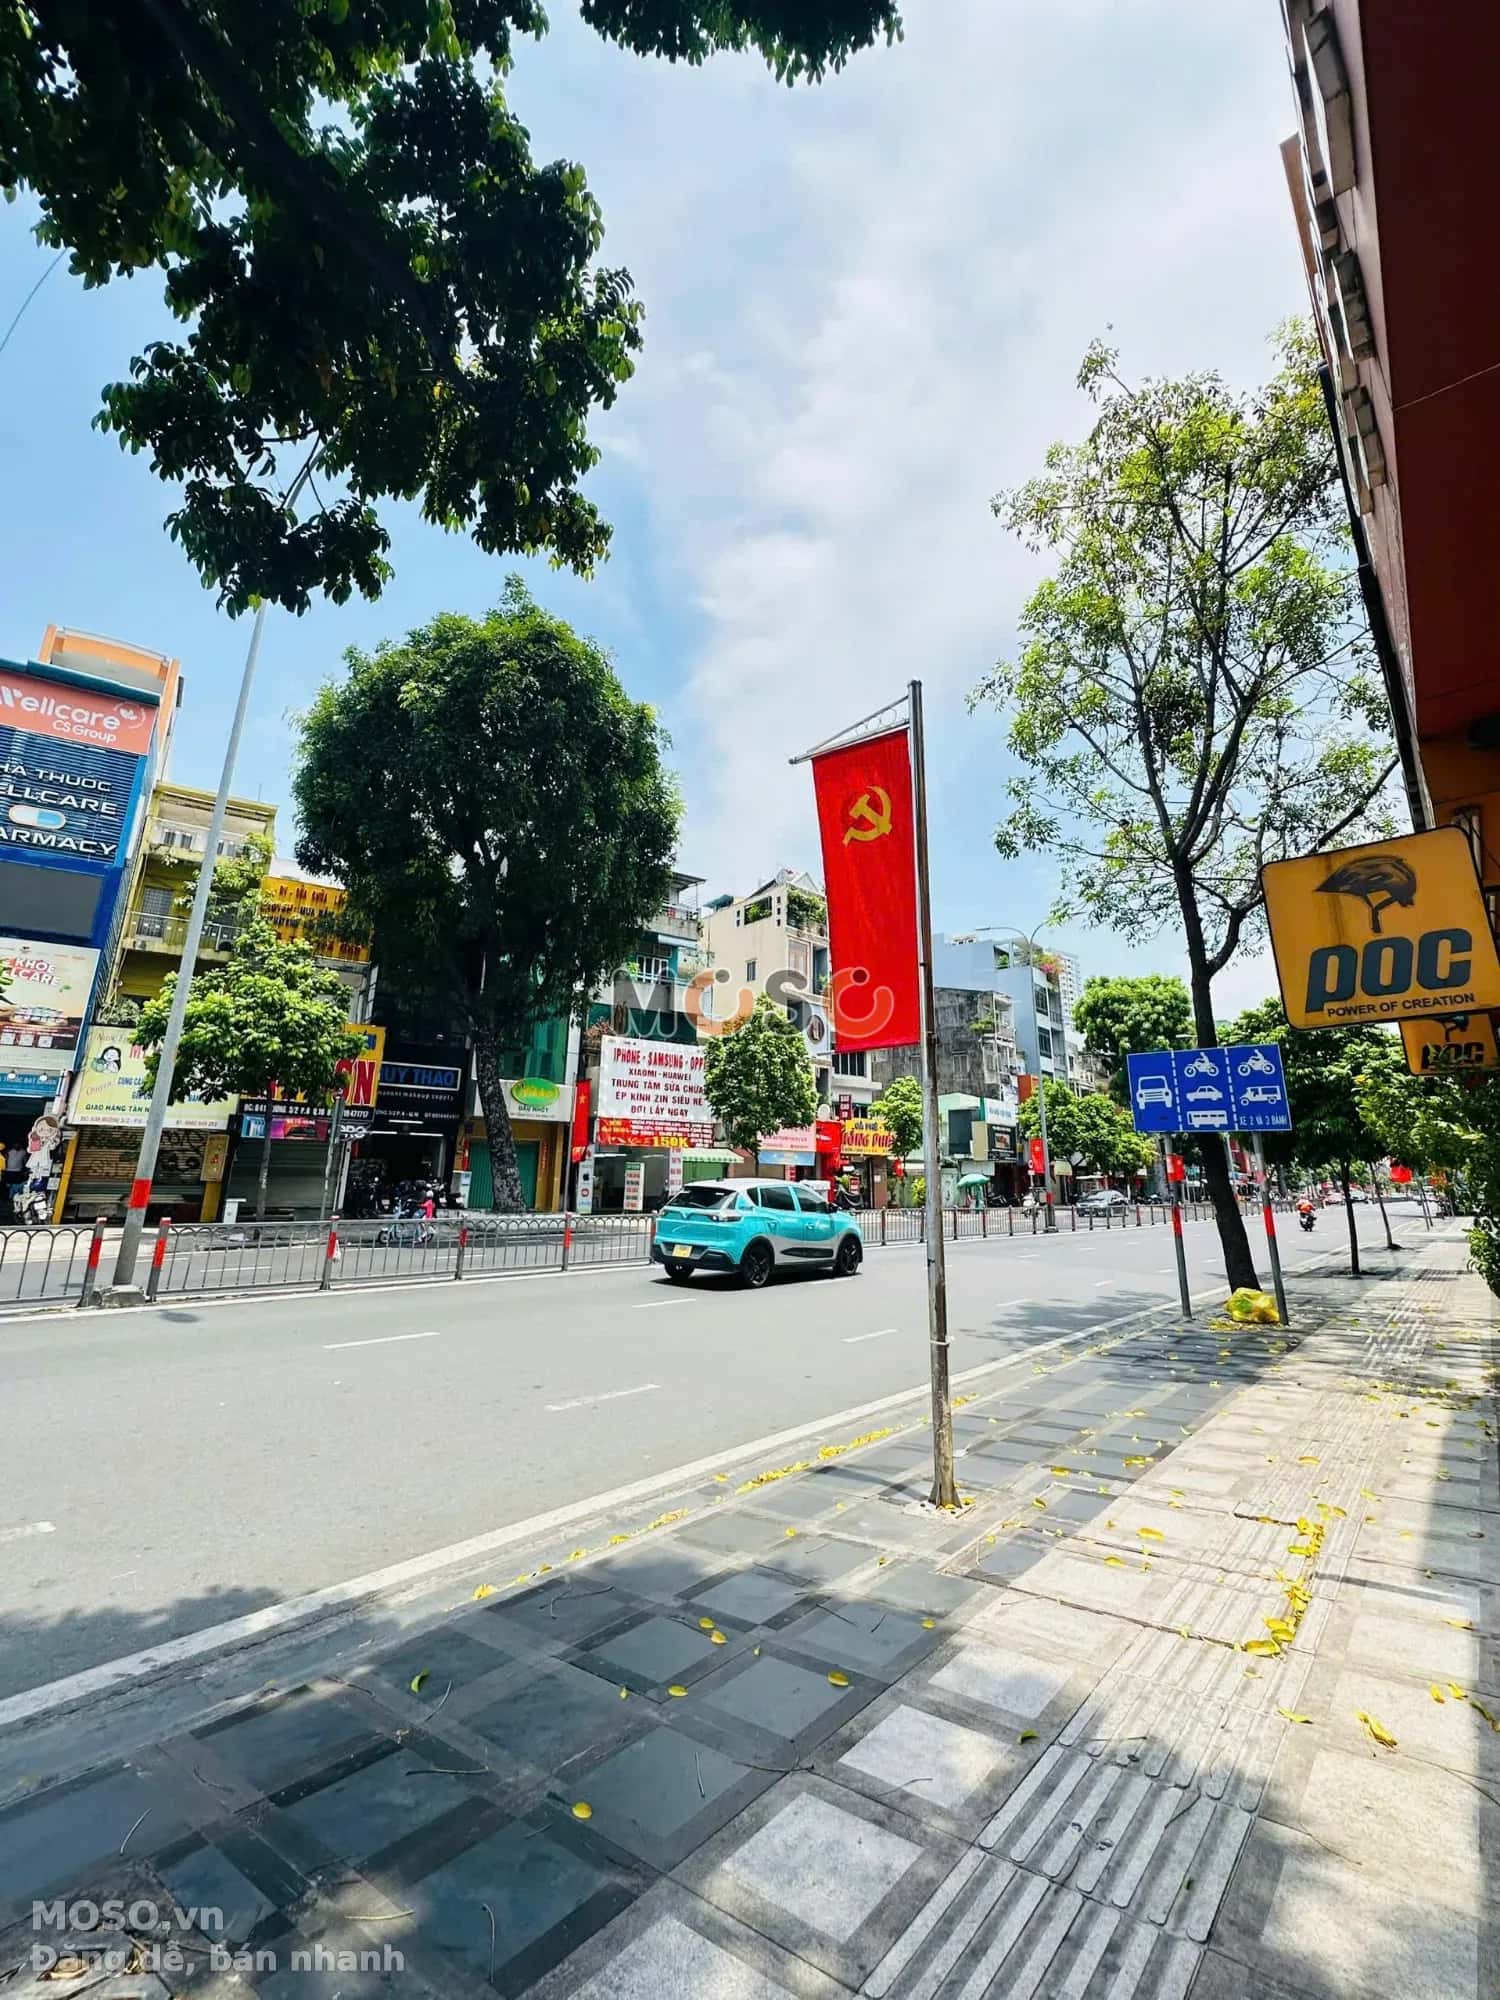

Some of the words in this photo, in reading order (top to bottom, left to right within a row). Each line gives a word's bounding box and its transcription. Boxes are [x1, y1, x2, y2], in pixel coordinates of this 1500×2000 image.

[52, 720, 71, 733] CS
[72, 725, 117, 744] Group
[1305, 928, 1472, 1014] POC
[1327, 1003, 1377, 1017] POWER
[1379, 1001, 1400, 1012] OF
[1402, 993, 1475, 1009] CREATION
[648, 1051, 683, 1069] SAMSUNG
[628, 1068, 657, 1078] XIAOMI
[662, 1071, 692, 1081] HUAWEI
[611, 1078, 639, 1089] TRUNG
[655, 1094, 668, 1104] ZIN
[1250, 1115, 1254, 1126] 2
[652, 1136, 689, 1148] 150K
